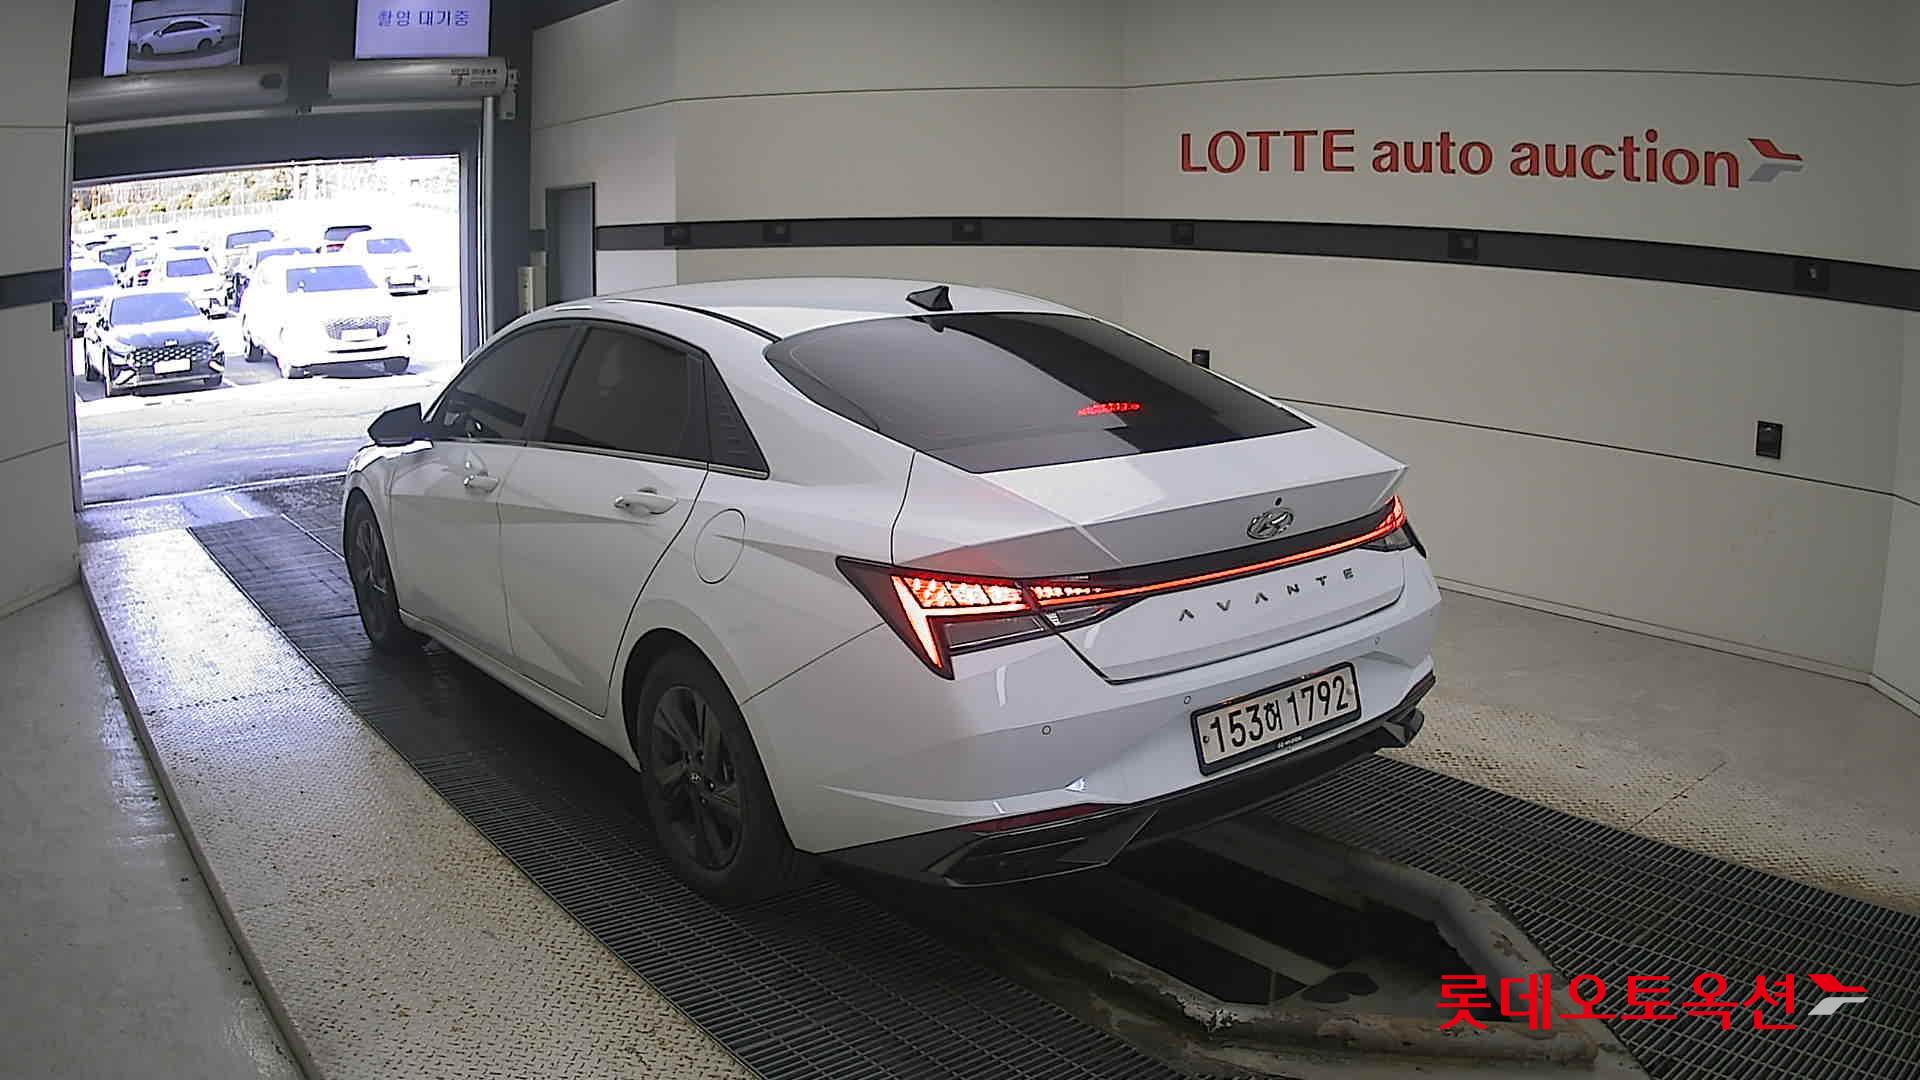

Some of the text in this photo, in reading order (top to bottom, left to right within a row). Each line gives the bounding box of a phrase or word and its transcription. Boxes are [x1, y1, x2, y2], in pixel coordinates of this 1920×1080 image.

[419, 9, 471, 27] 대기중
[1181, 129, 1740, 188] LOTTE auto auction
[1179, 568, 1354, 621] AVANTE
